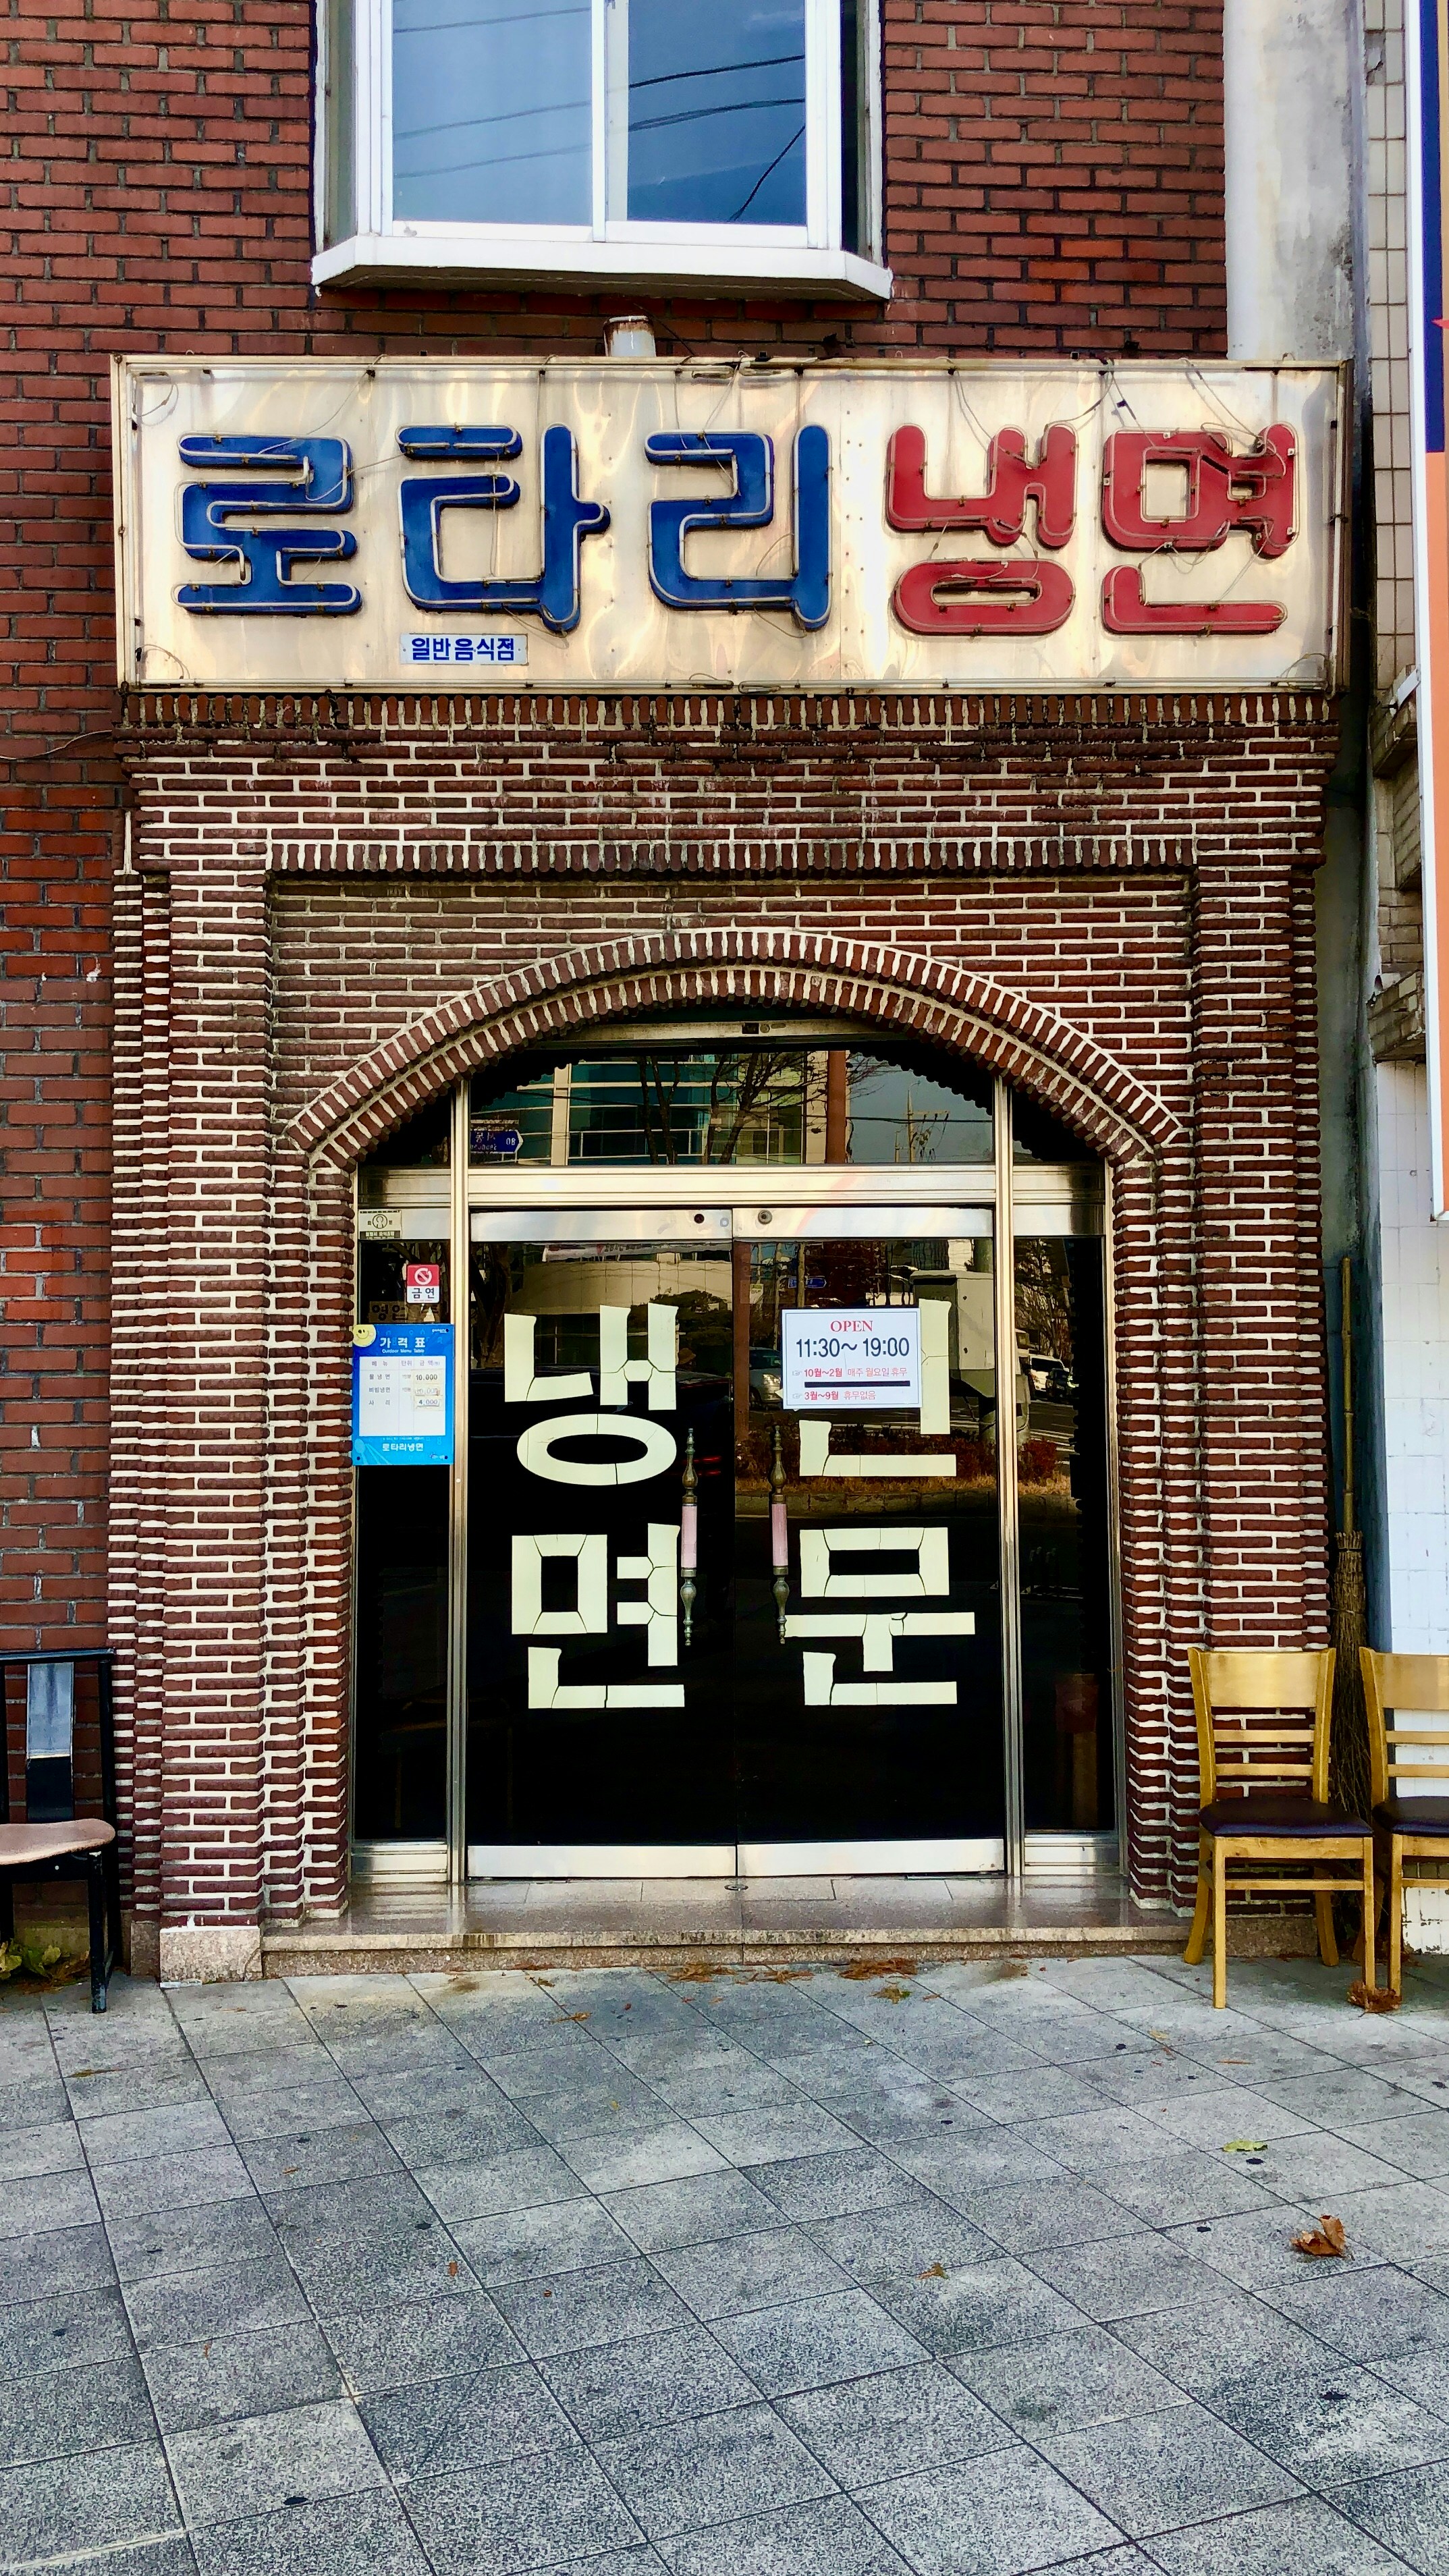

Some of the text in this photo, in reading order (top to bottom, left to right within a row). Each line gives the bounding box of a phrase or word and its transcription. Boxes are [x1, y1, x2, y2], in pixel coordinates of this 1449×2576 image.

[411, 637, 515, 661] 일반음식점
[412, 1287, 435, 1299] 금연
[830, 1320, 873, 1332] OPEN
[863, 1337, 910, 1357] 19:00
[804, 1367, 908, 1377] 10월~2월 매주 월요일 휴무
[804, 1390, 839, 1400] 3월~9월
